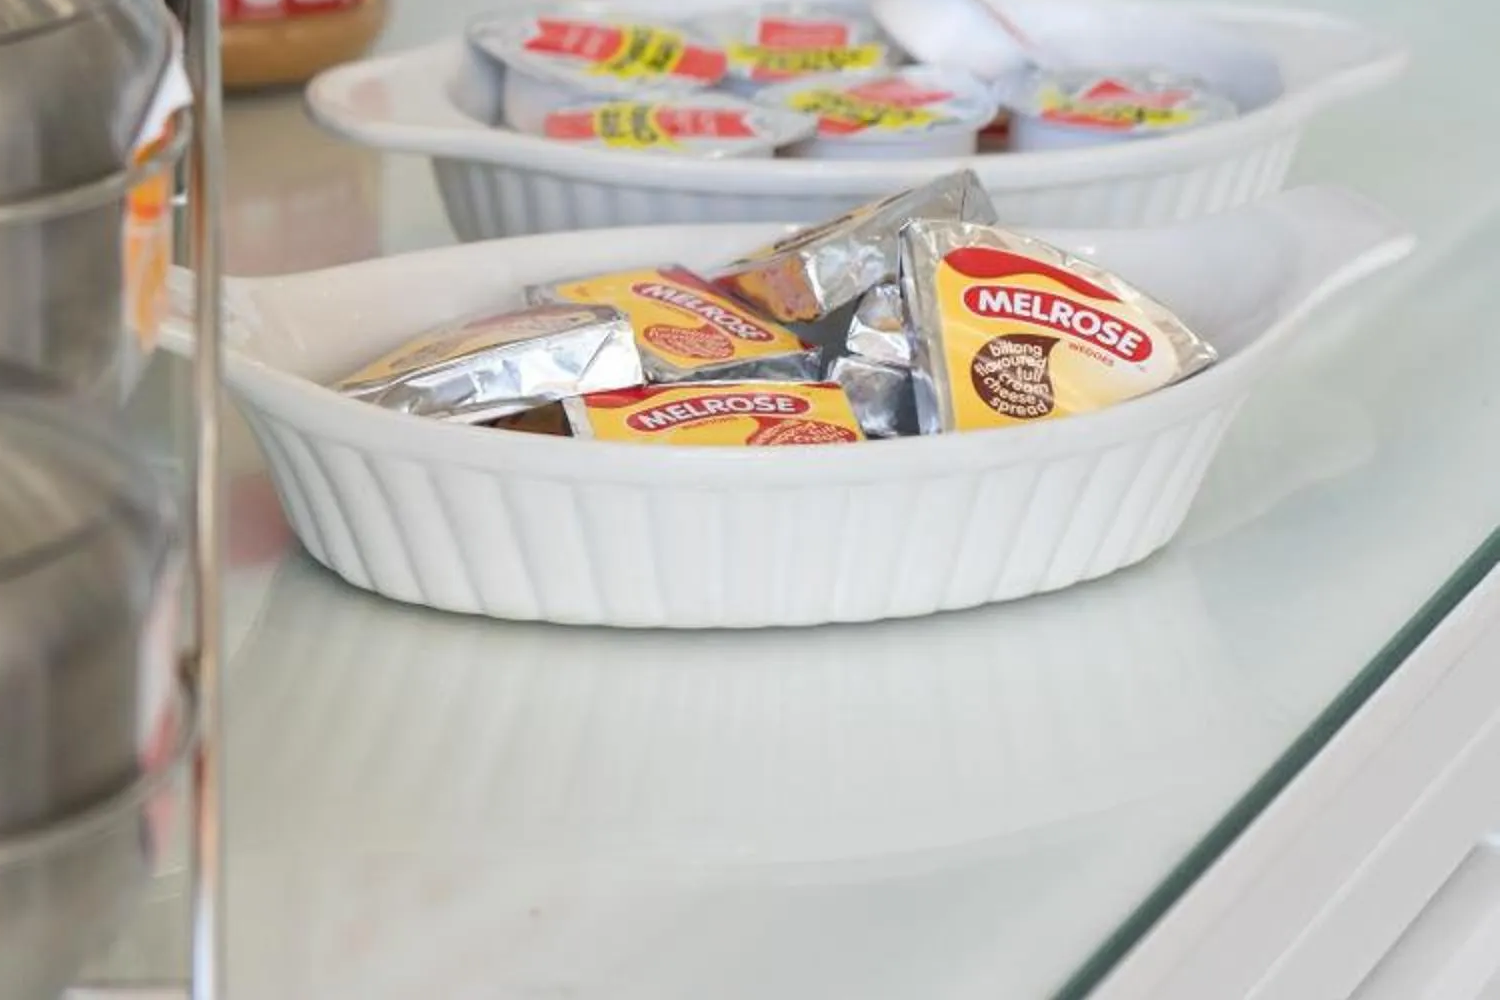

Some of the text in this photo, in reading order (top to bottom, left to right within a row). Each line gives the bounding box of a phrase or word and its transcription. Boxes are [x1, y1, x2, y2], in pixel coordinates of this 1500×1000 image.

[640, 282, 768, 341] MELROSE
[977, 288, 1145, 357] MELROSE
[973, 354, 1047, 378] flavoured
[982, 375, 1037, 404] cheese
[999, 372, 1050, 395] cream
[637, 394, 797, 429] MELROSE
[990, 396, 1049, 417] spread
